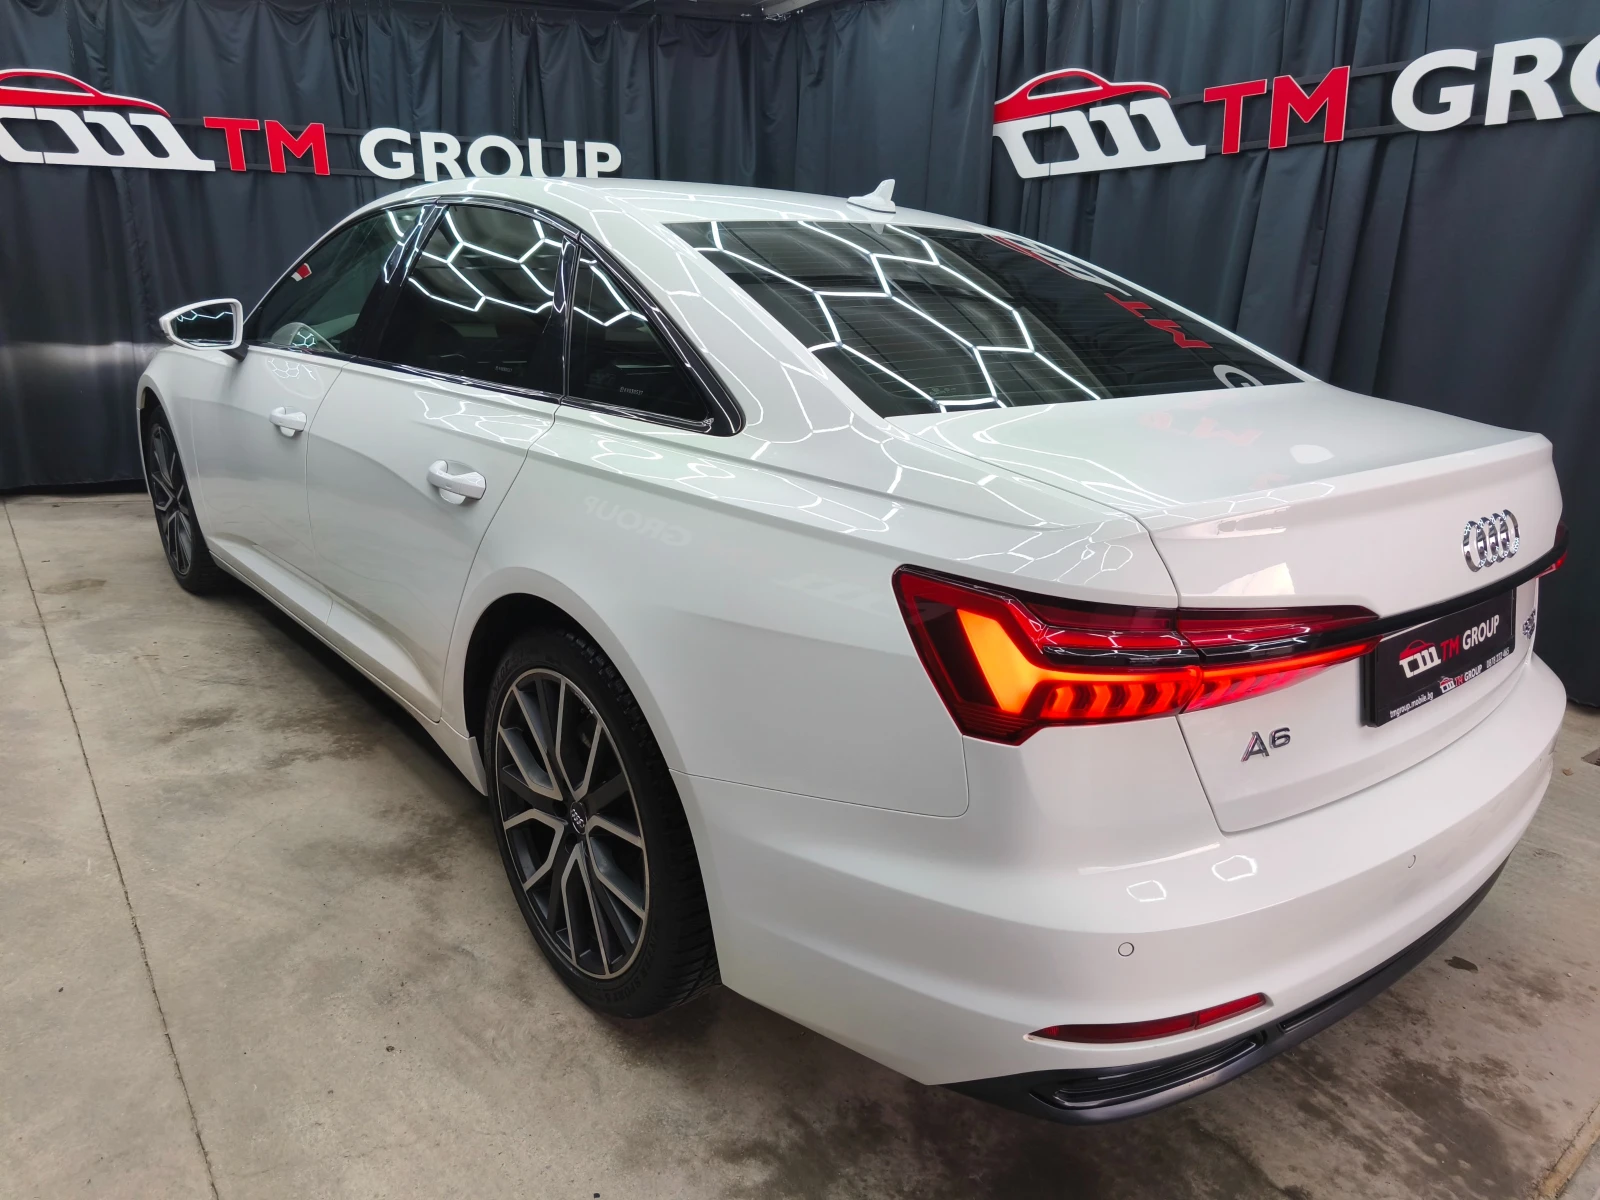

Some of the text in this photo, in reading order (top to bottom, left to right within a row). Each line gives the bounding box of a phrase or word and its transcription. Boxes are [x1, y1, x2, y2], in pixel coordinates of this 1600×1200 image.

[1203, 65, 1350, 154] TM
[203, 116, 622, 181] TM GROUP
[1440, 635, 1460, 661] TM
[1462, 614, 1500, 650] GROUP
[1464, 664, 1483, 681] GROUP
[1241, 727, 1291, 762] A6
